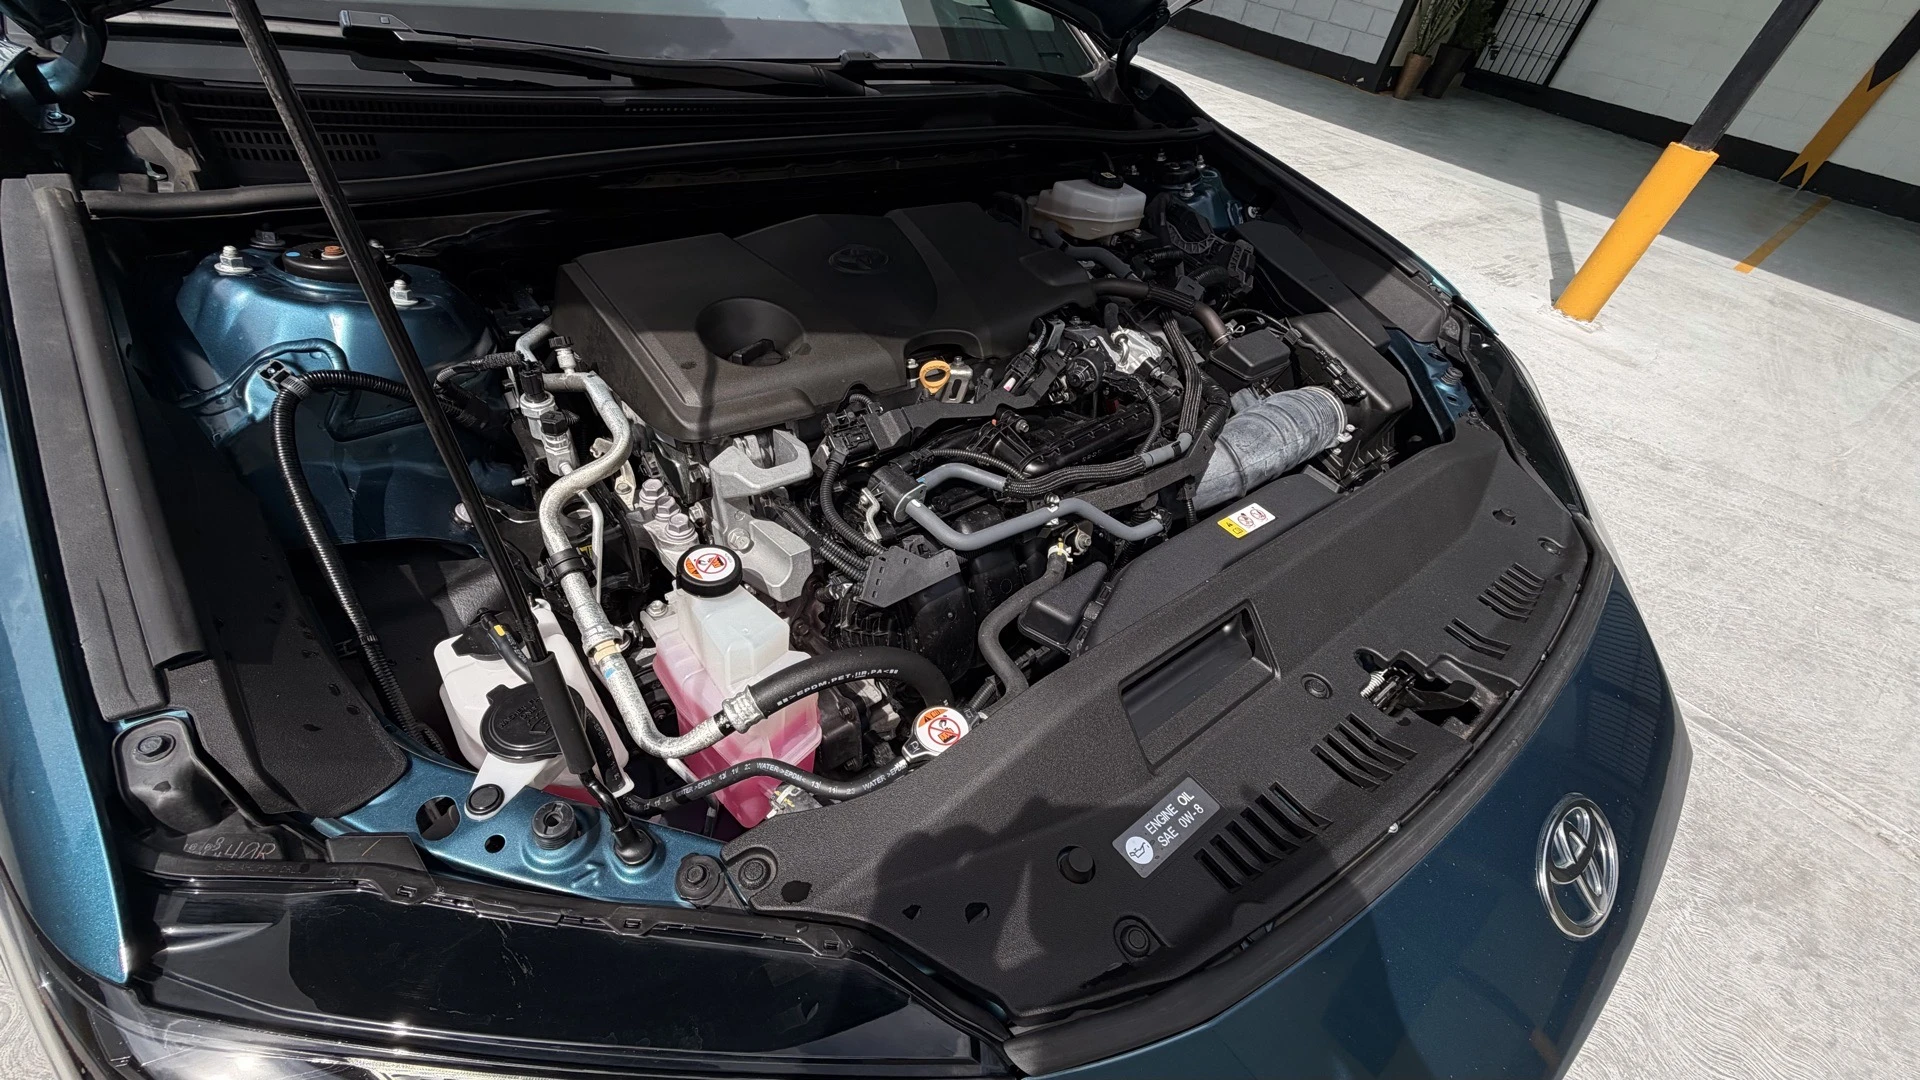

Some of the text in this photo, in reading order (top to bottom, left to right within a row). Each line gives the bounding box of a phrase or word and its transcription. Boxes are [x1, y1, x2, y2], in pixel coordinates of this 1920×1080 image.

[756, 762, 779, 773] WATER
[861, 774, 887, 791] WATER
[1144, 791, 1195, 835] ENGINE OIL
[1157, 826, 1179, 847] SAE
